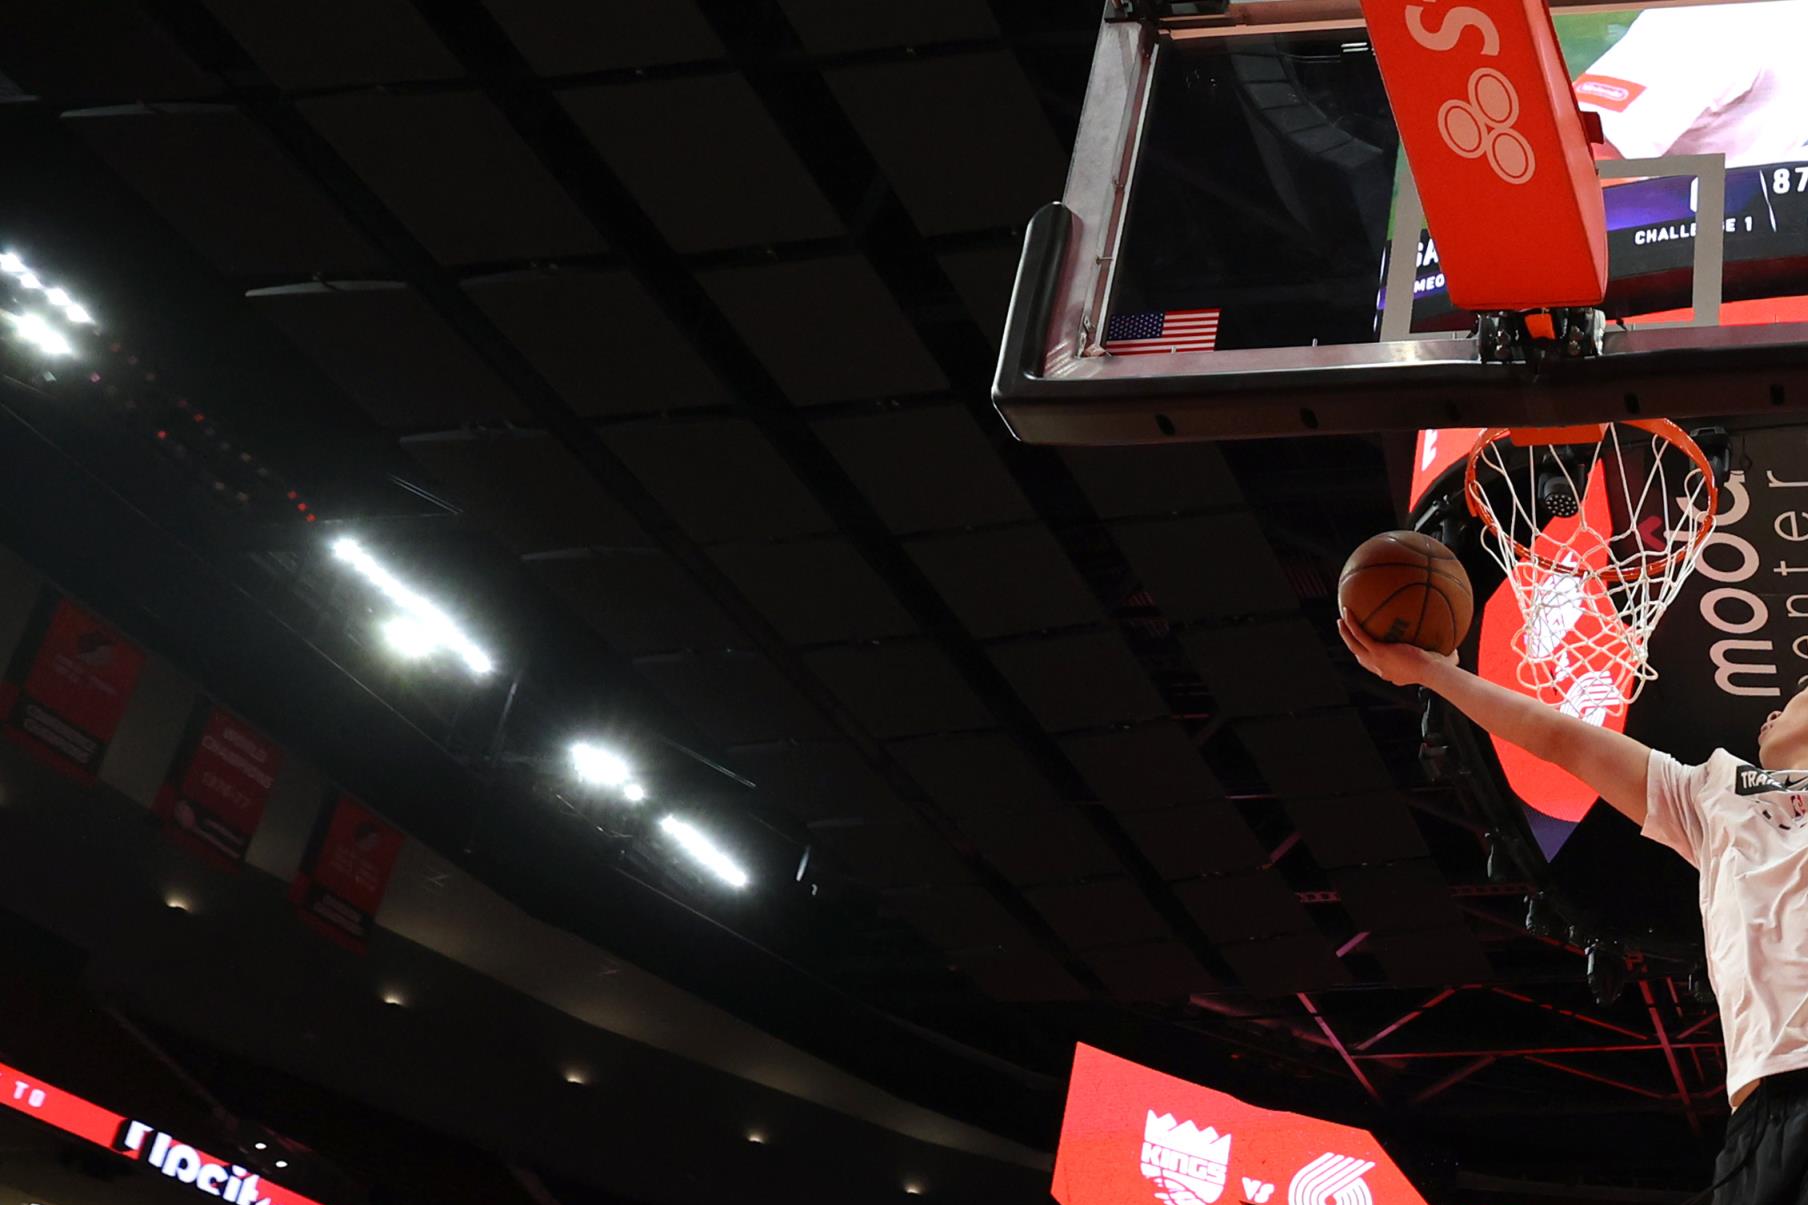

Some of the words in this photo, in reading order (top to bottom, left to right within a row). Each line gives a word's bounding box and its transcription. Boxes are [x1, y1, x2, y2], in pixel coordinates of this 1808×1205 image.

[1634, 216, 1737, 245] CHALLEE
[1744, 216, 1753, 232] 1
[13, 1080, 47, 1108] TO
[1140, 1140, 1228, 1186] KINGS
